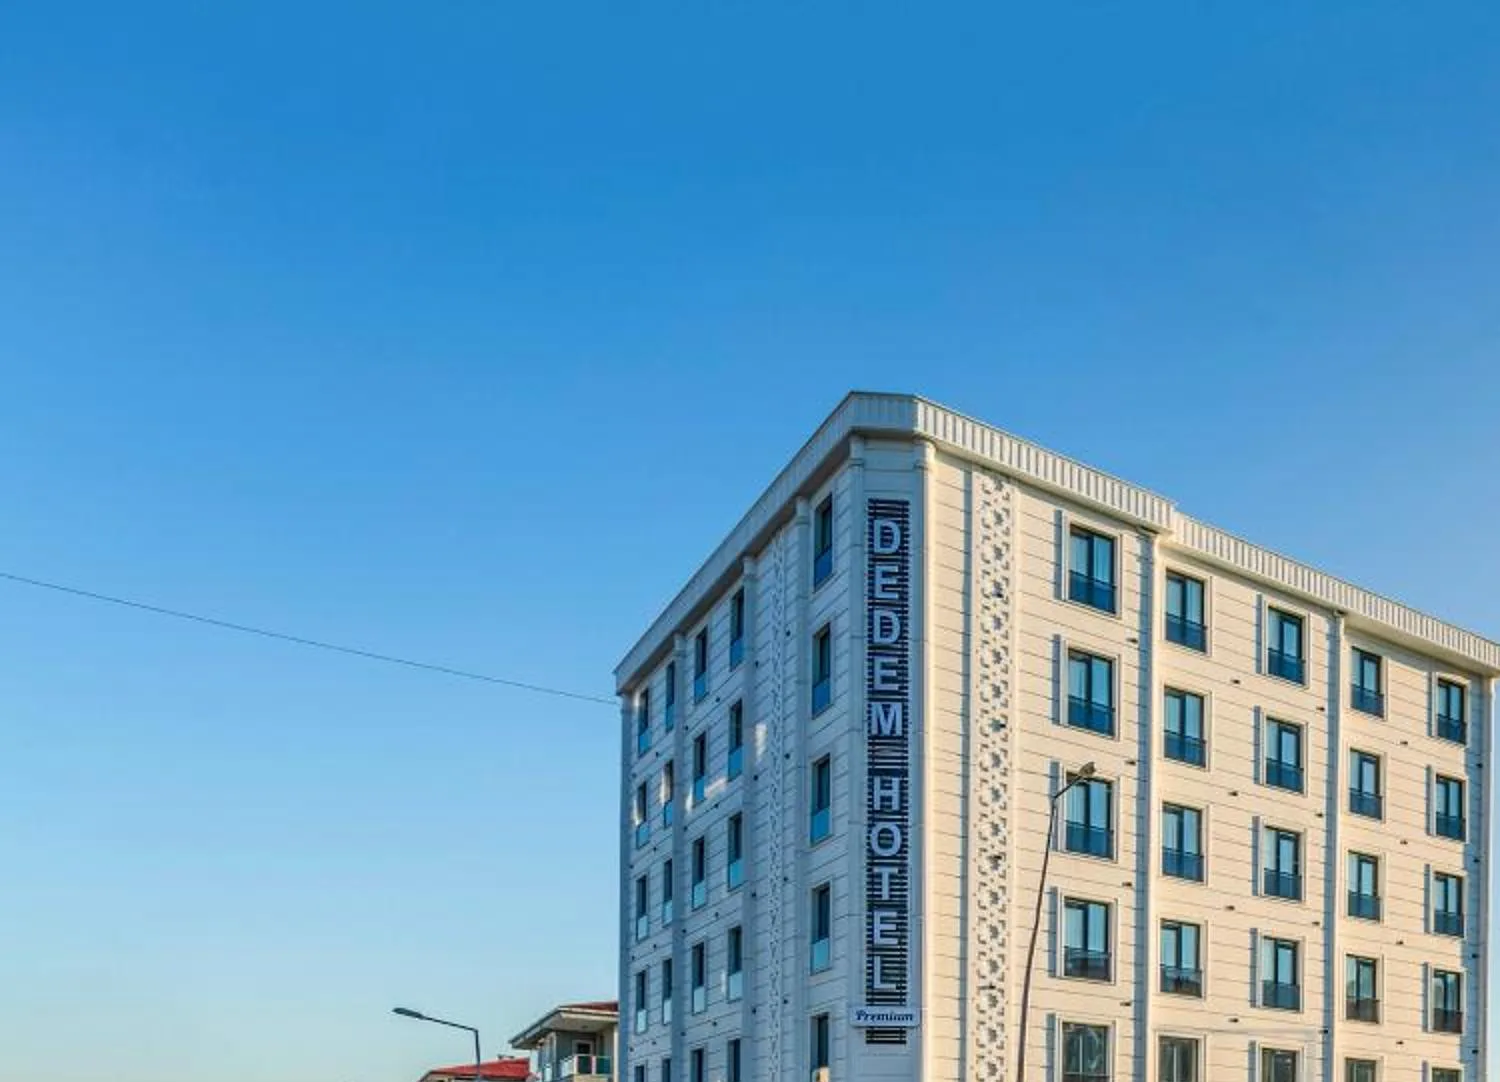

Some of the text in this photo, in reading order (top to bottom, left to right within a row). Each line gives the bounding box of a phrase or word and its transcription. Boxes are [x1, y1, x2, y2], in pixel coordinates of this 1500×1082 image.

[870, 519, 902, 990] DEDEM HOTEL
[855, 1009, 914, 1021] Premium
